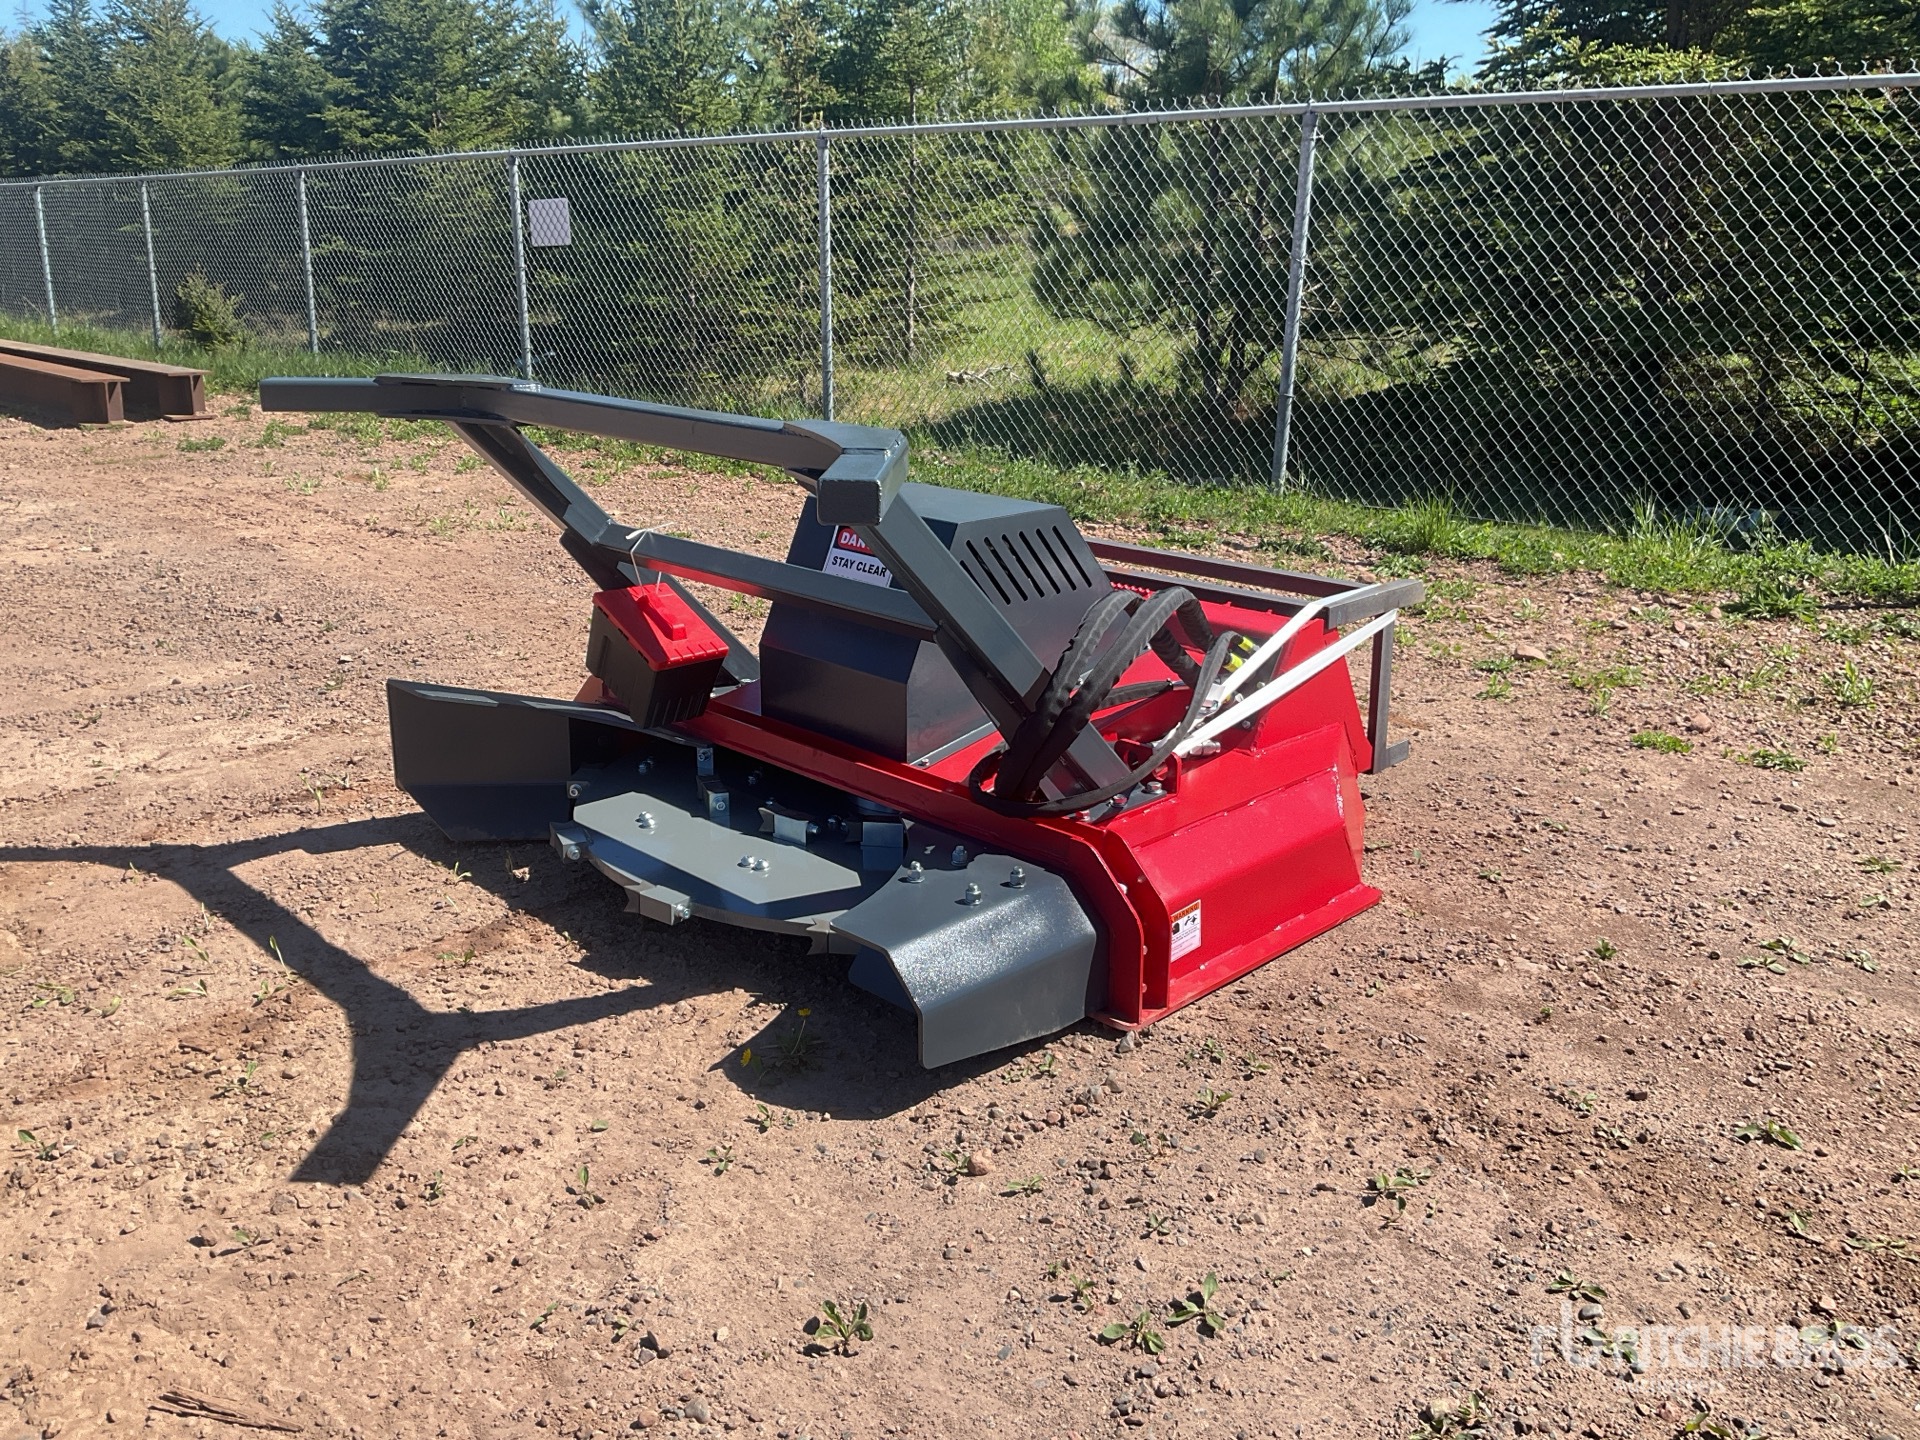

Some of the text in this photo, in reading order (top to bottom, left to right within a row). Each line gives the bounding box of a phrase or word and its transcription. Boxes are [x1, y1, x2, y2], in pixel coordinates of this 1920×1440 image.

[840, 531, 870, 550] DAN
[831, 555, 856, 570] STAY
[856, 561, 887, 578] CLEAR
